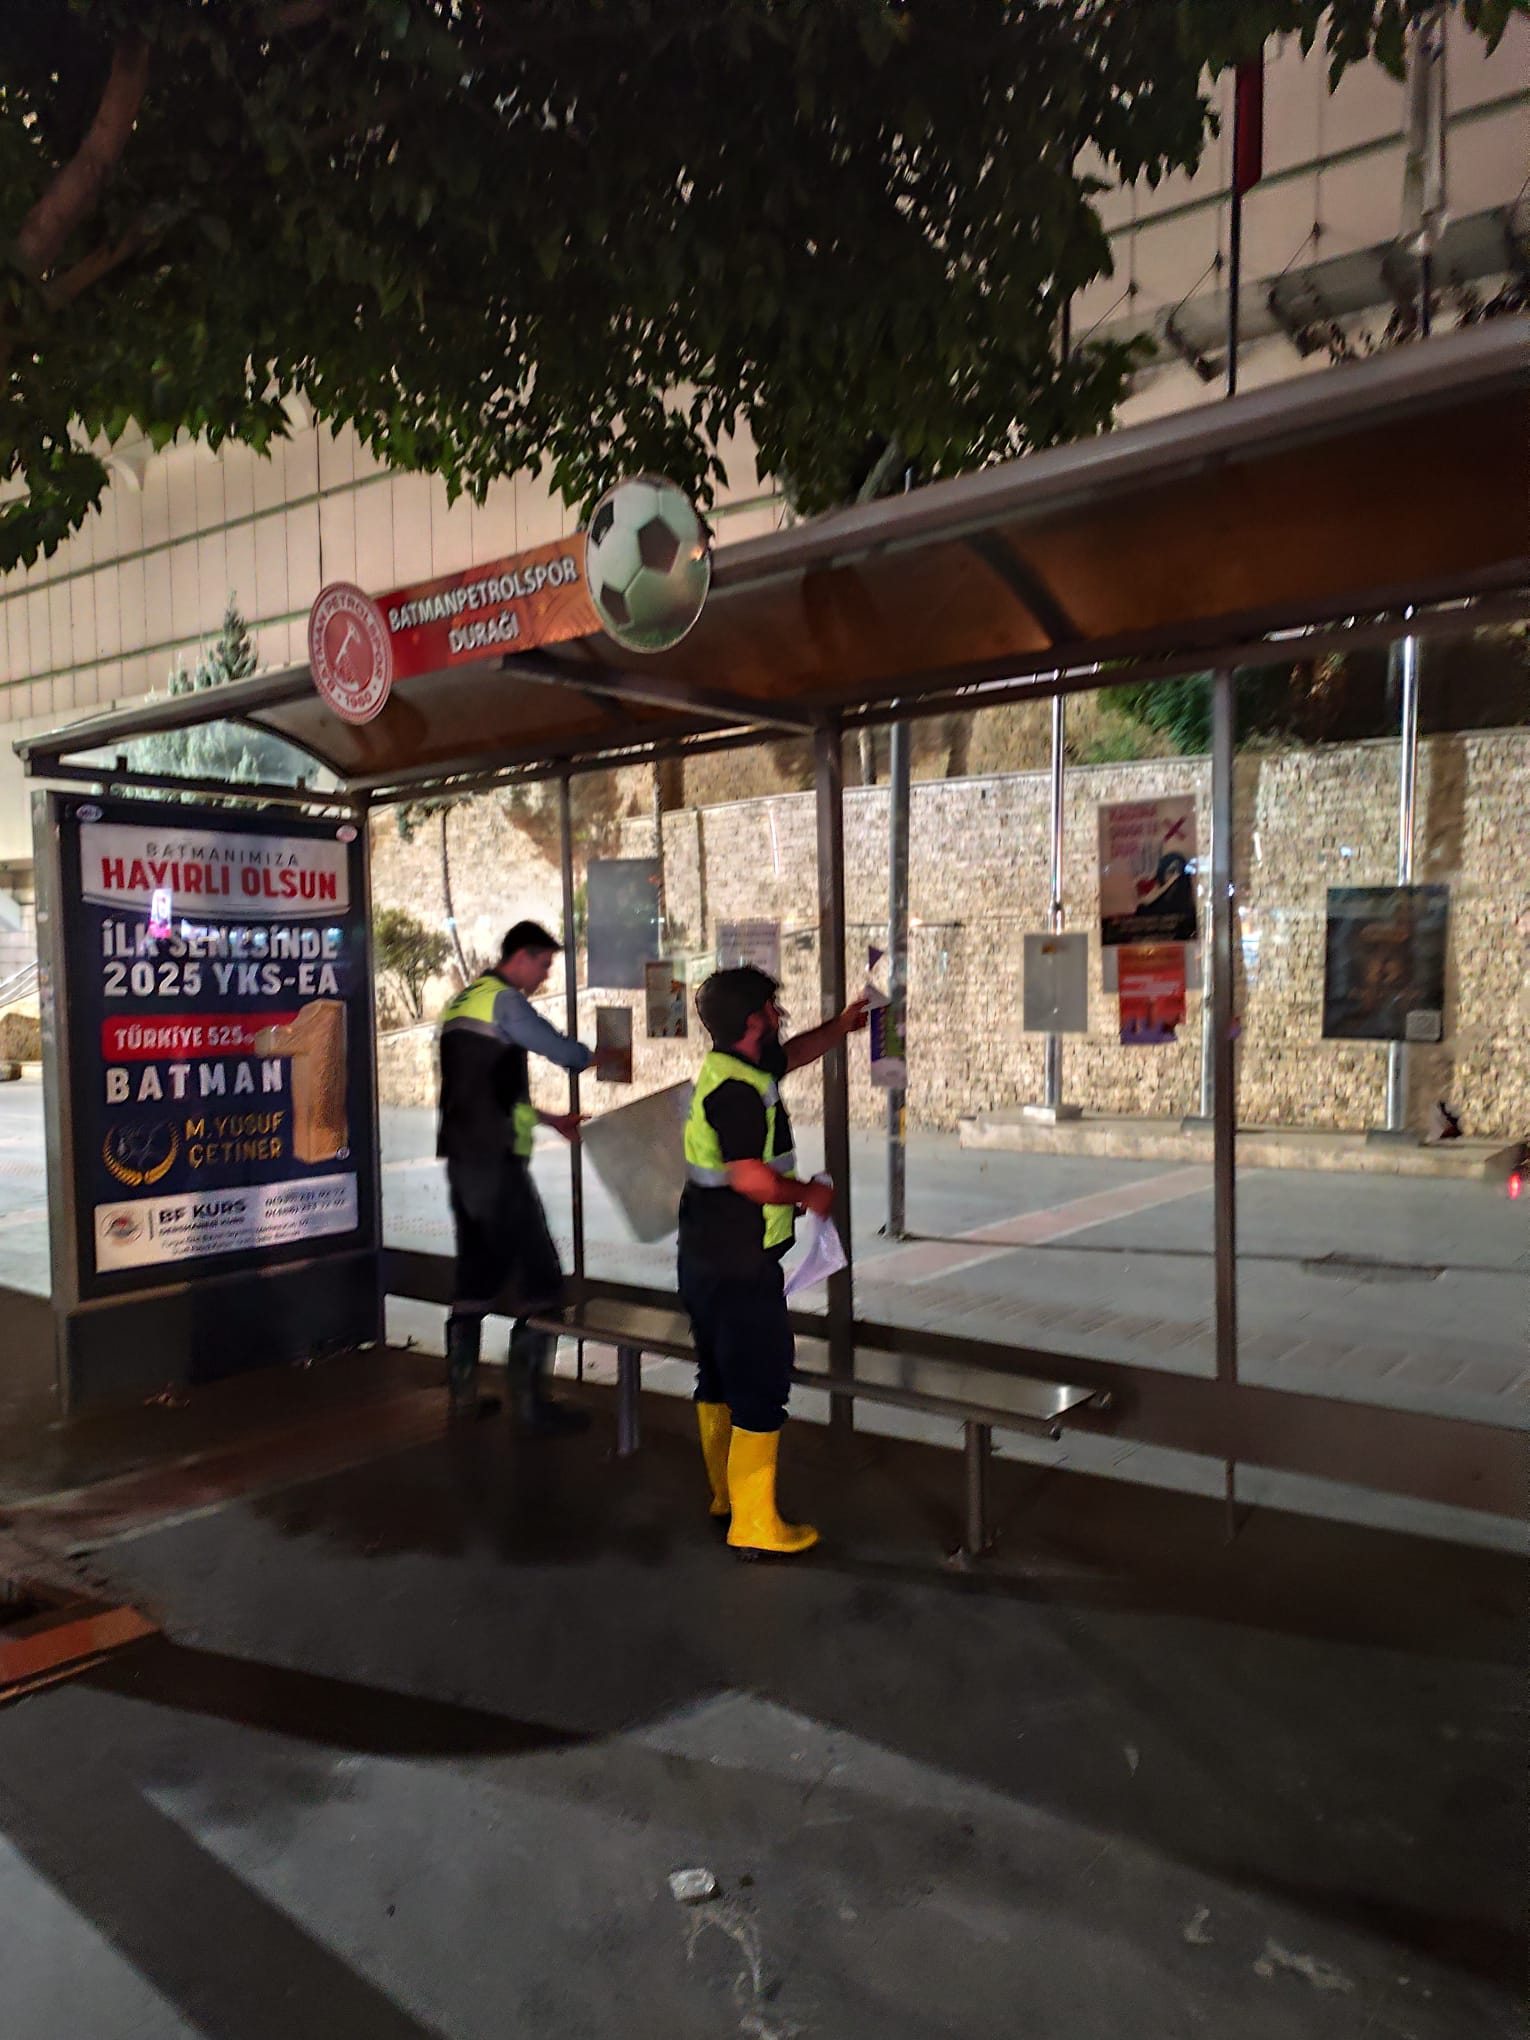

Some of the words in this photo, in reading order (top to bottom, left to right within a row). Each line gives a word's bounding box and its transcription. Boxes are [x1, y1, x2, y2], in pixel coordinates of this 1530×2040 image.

[388, 555, 580, 632] BATMANPETROLSPOR
[449, 615, 519, 654] DURAĞI
[145, 841, 299, 867] BATMANIMIZA
[101, 857, 230, 896] HAYIRLI
[241, 867, 337, 900] OLSUN
[168, 922, 339, 960] SENESİNDE
[103, 961, 202, 997] 2025
[212, 962, 339, 996] YKS-EA
[115, 1025, 203, 1051] TÜRKİYE
[106, 1059, 283, 1104] BATMAN
[188, 1137, 283, 1169] ÇETİNER
